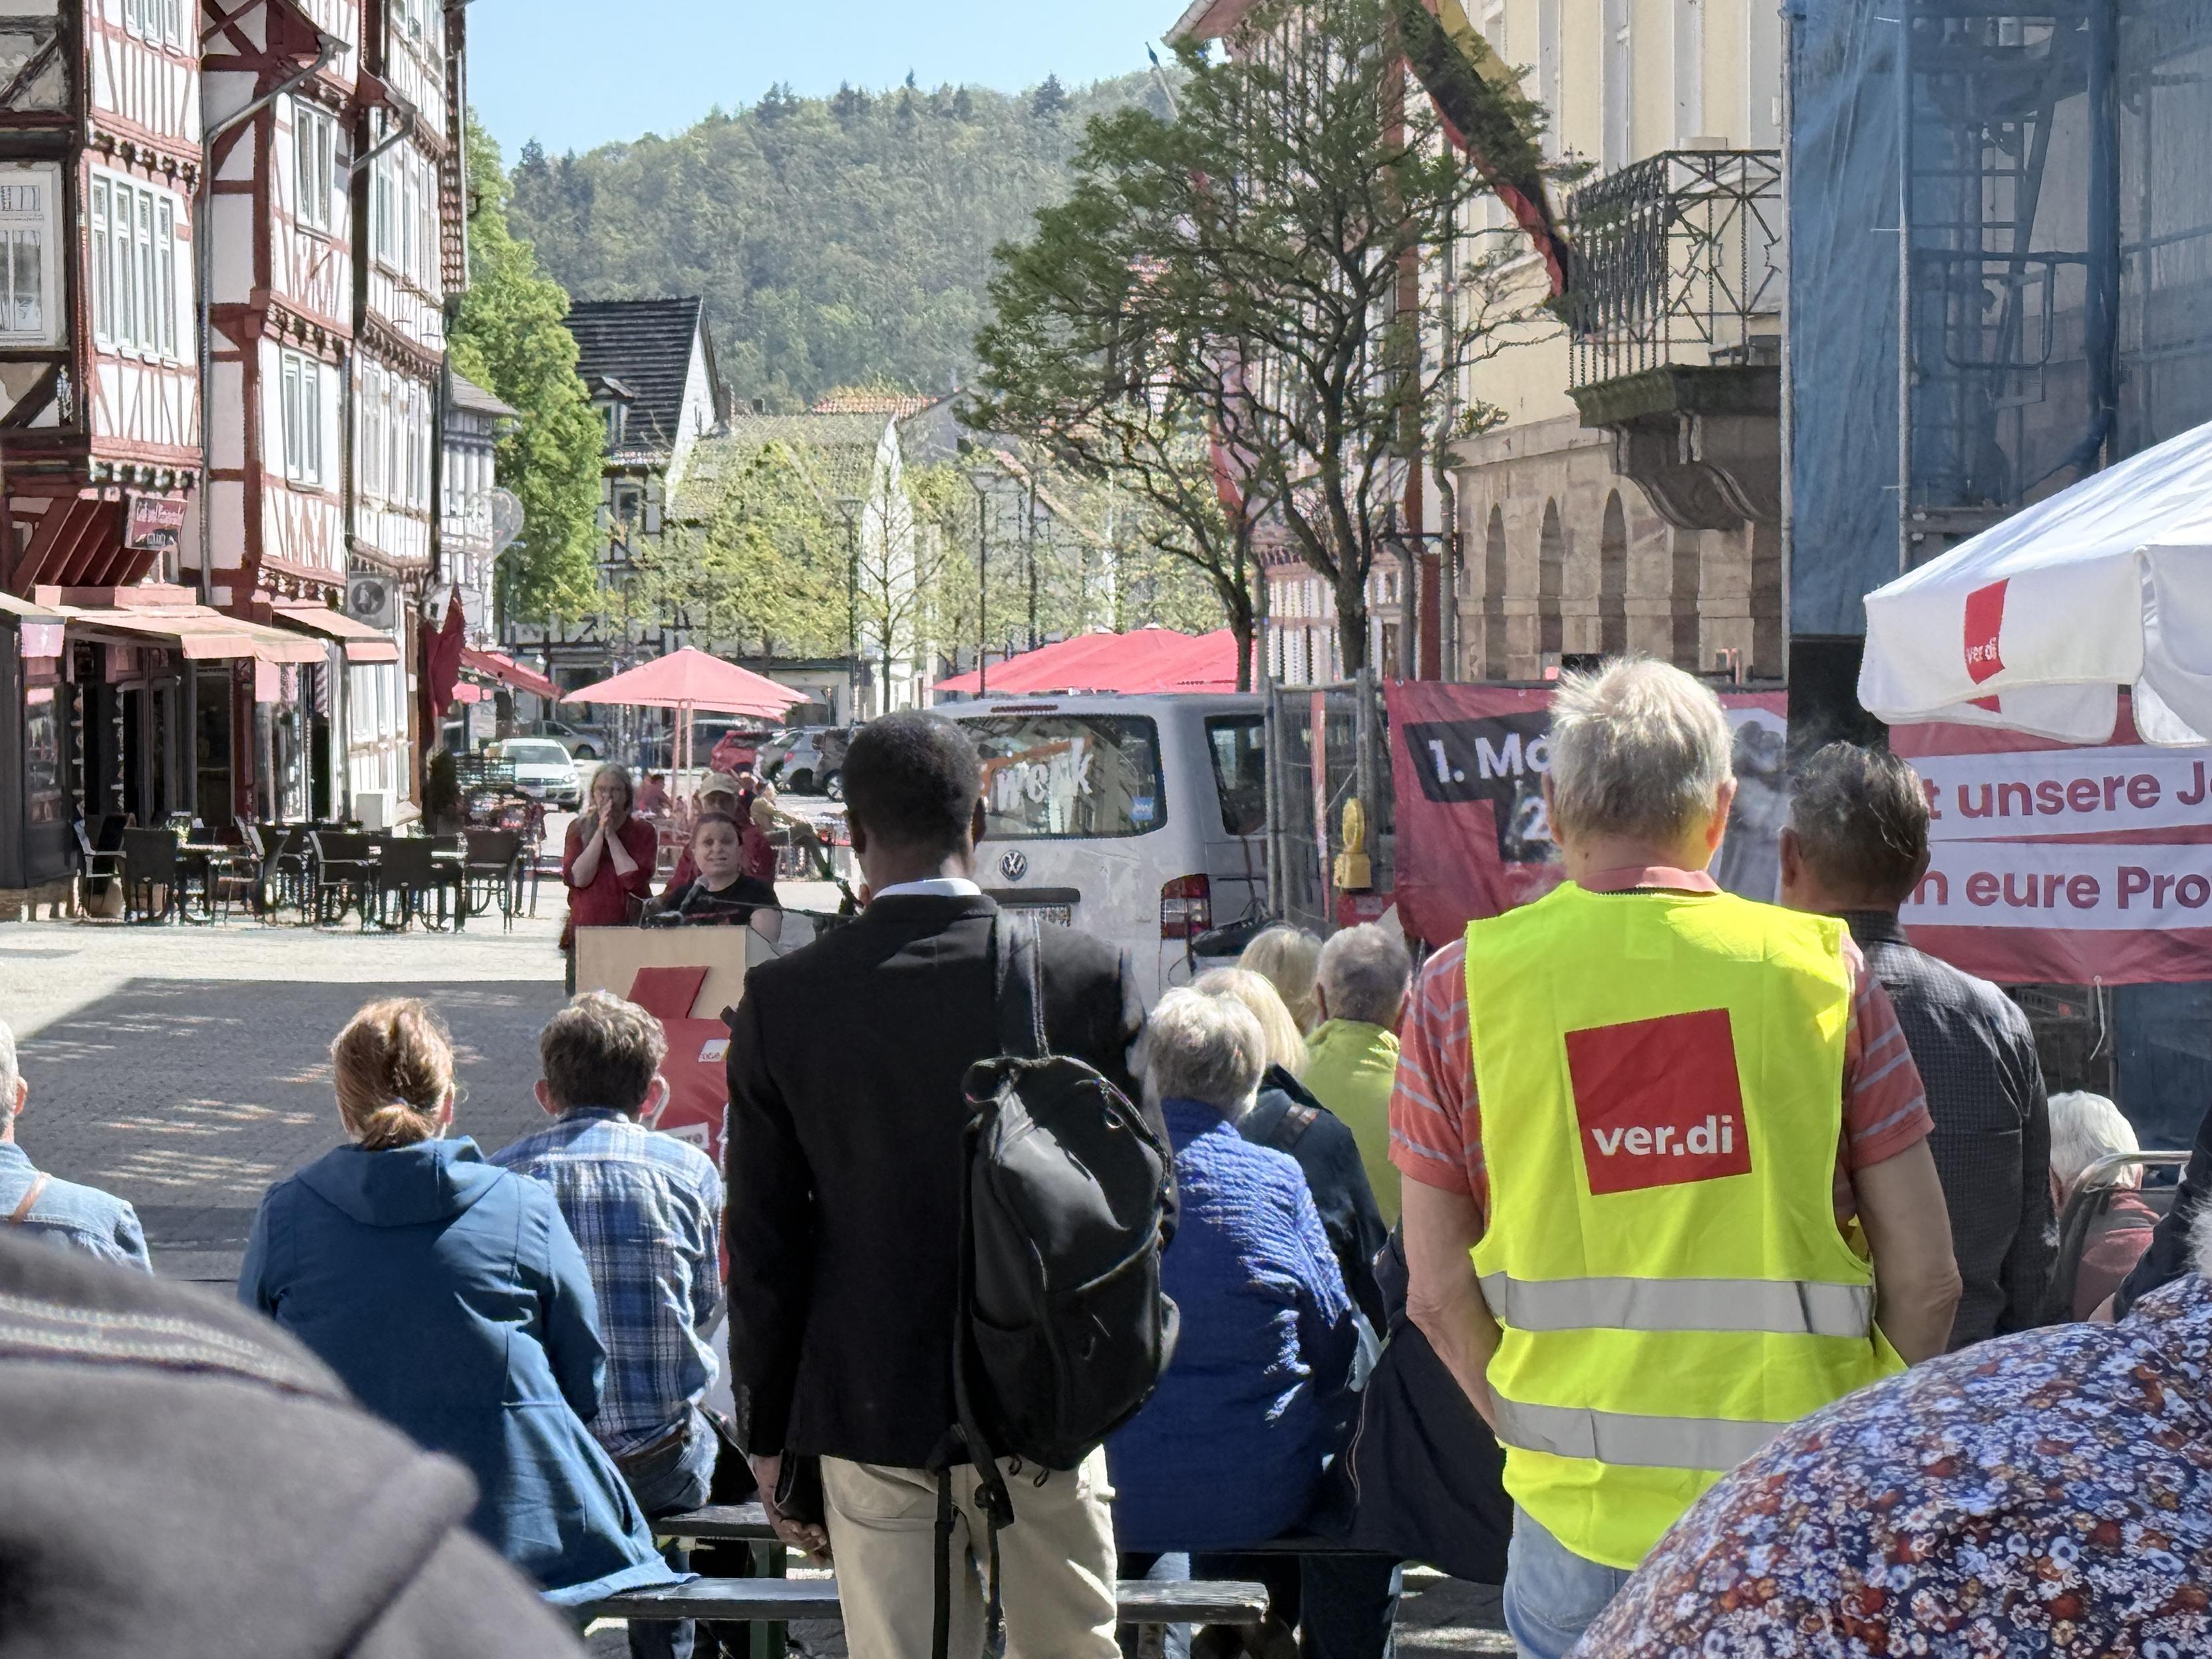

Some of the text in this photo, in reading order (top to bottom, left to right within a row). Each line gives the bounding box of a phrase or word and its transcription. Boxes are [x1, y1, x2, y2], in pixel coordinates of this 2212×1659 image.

[1428, 739, 1465, 783] 1.
[1958, 774, 2161, 819] unsere
[2176, 760, 2212, 806] J
[1901, 865, 2212, 909] n eure Pro
[1591, 1114, 1733, 1156] ver.di
